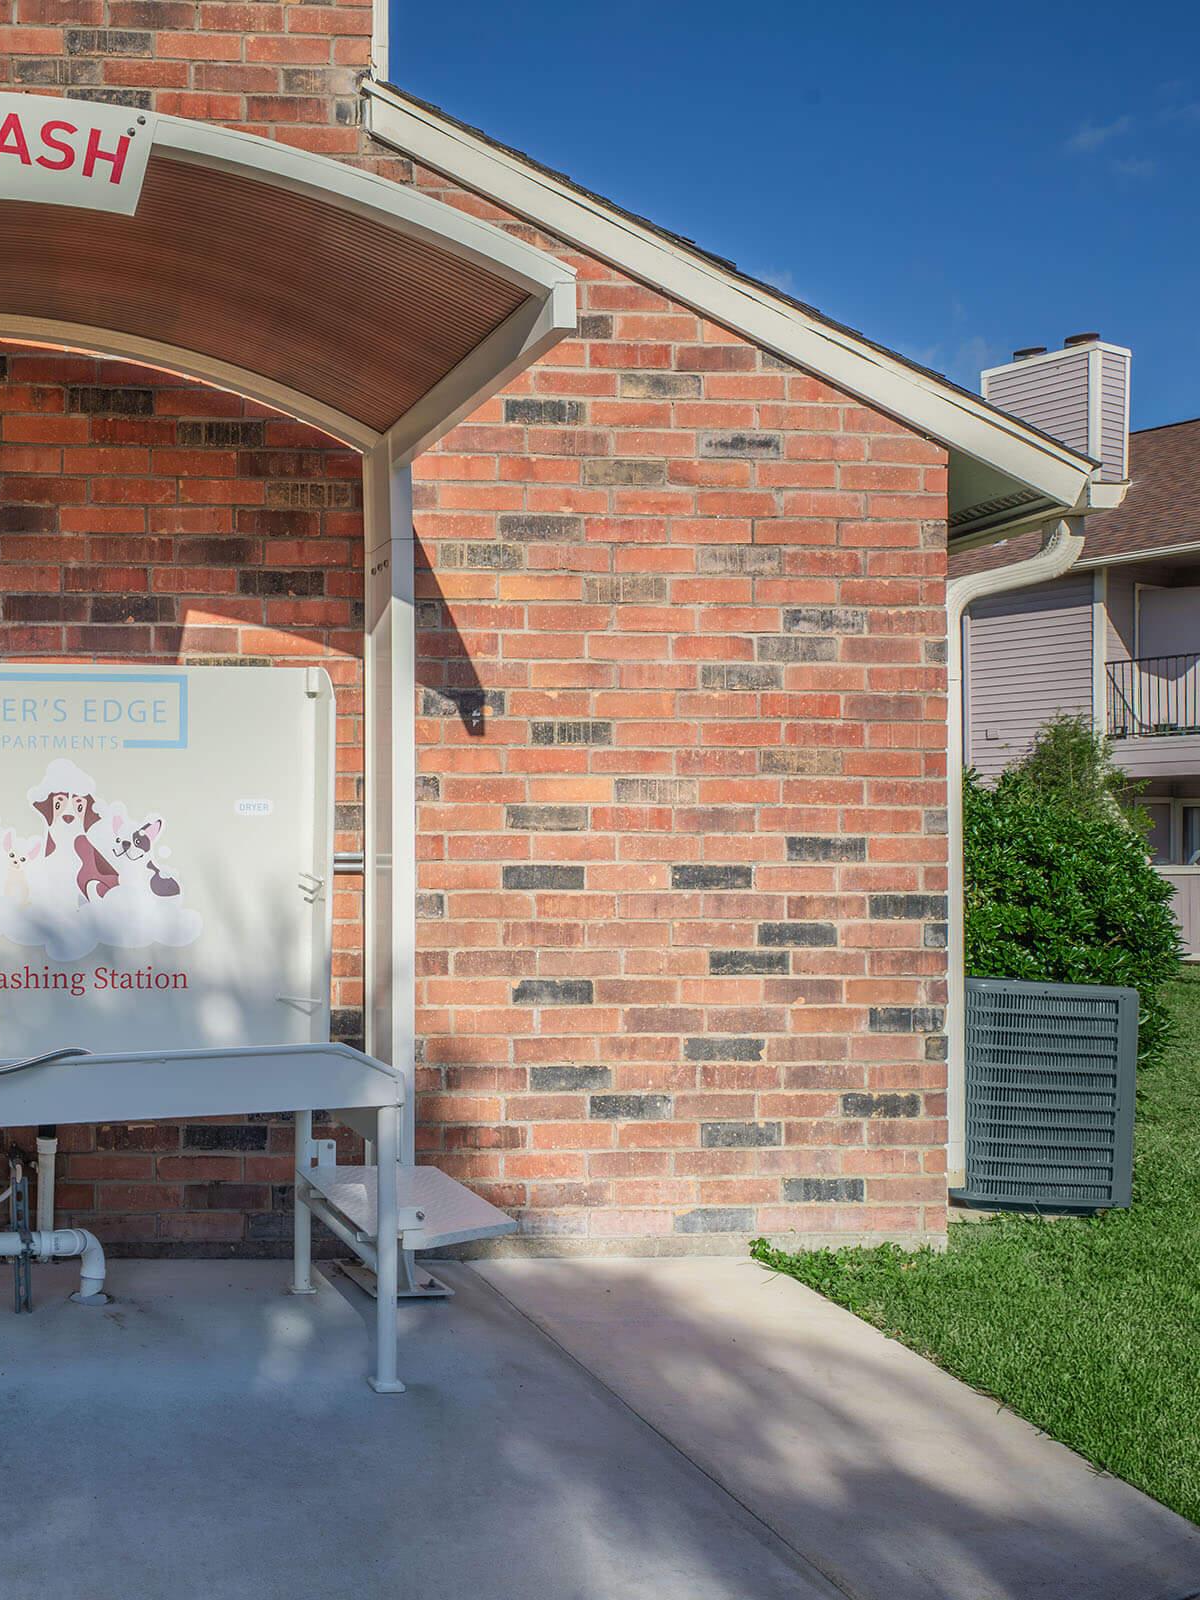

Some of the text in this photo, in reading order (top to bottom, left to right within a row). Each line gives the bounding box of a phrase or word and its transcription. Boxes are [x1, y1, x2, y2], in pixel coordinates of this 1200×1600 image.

[84, 699, 168, 724] EDGE
[239, 803, 269, 811] DRYER
[94, 966, 189, 990] Station
